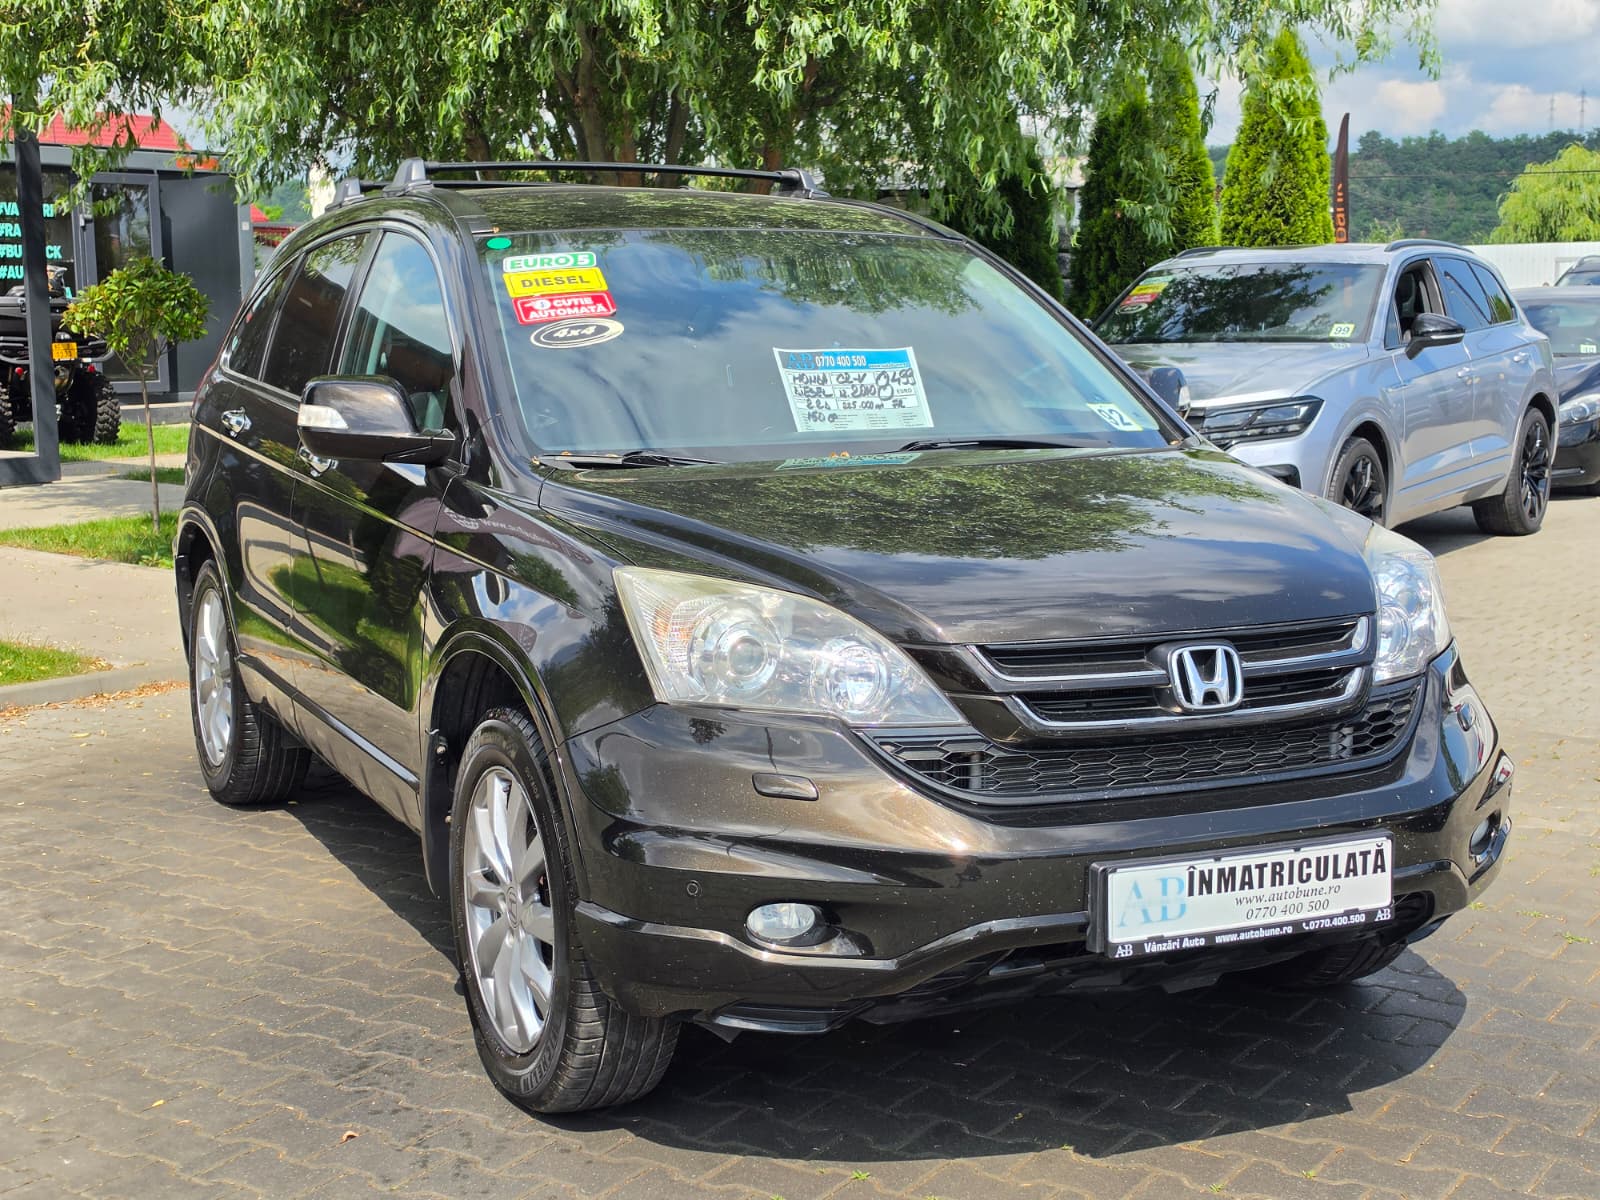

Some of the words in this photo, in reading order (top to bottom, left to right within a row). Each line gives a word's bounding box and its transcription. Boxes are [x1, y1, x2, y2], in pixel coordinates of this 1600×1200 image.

[510, 256, 571, 270] EURO
[521, 275, 590, 289] DIESEL
[553, 297, 594, 307] CUTIE
[529, 304, 607, 319] AUTOMATĂ
[553, 325, 597, 338] 4x4
[1334, 326, 1350, 336] 99
[837, 355, 850, 367] 400
[1186, 842, 1386, 897] ÎNMATRICULATĂ
[1117, 876, 1187, 927] AB
[1235, 884, 1341, 906] www.autobune.ro
[1246, 905, 1277, 920] 0770
[1281, 902, 1303, 915] 400
[1308, 899, 1330, 912] 500
[1144, 939, 1180, 953] Vânzări
[1182, 937, 1205, 949] Auto
[1215, 926, 1293, 944] www.autobune.ro
[1309, 914, 1366, 930] 0770.400.500
